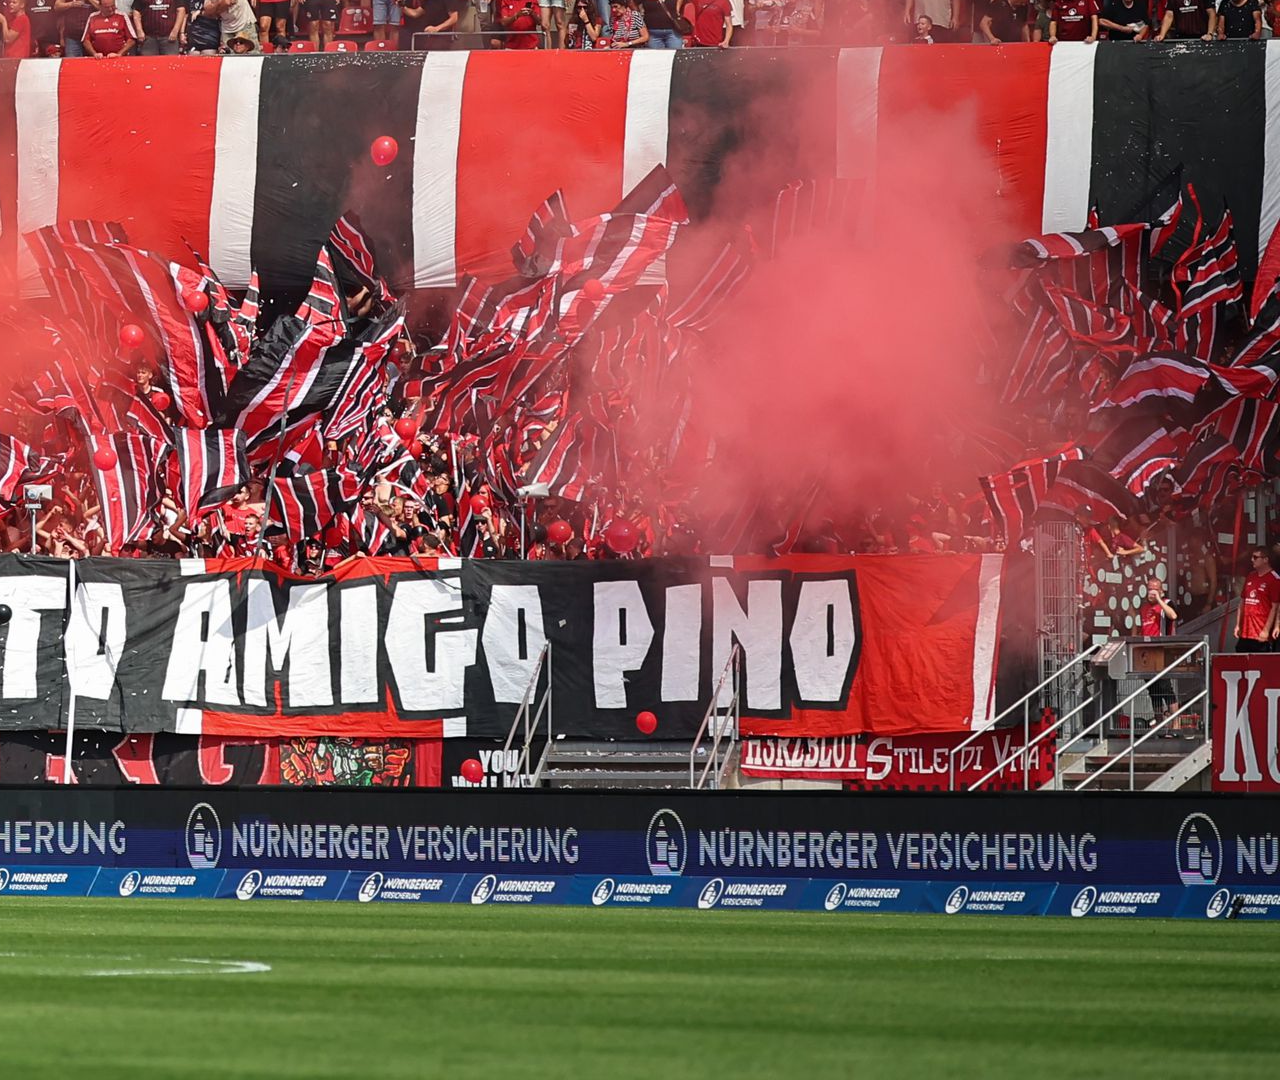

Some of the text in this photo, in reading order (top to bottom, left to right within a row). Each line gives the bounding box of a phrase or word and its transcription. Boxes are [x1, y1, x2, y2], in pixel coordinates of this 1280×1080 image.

[161, 577, 544, 711] AMIGO
[592, 576, 858, 711] PINO
[478, 749, 519, 773] YOU
[230, 819, 580, 865] NÜRNBERGER VERSICHERUNG
[698, 827, 1098, 872] NÜRNBERGER VERSICHERUNG
[11, 872, 69, 884] NÜRNBERGER
[142, 875, 197, 886] NÜRNBERGER
[264, 875, 328, 887] NÜRNBERGER
[384, 877, 443, 890] NÜRNBERGER
[497, 880, 556, 893] NÜRNBERGER
[616, 882, 672, 895] NÜRNBERGER
[725, 883, 787, 896] NÜRNBERGER
[847, 887, 900, 899] NÜRNBERGER
[969, 891, 1026, 903] NÜRNBERGER
[1097, 891, 1161, 904] NÜRNBERGER
